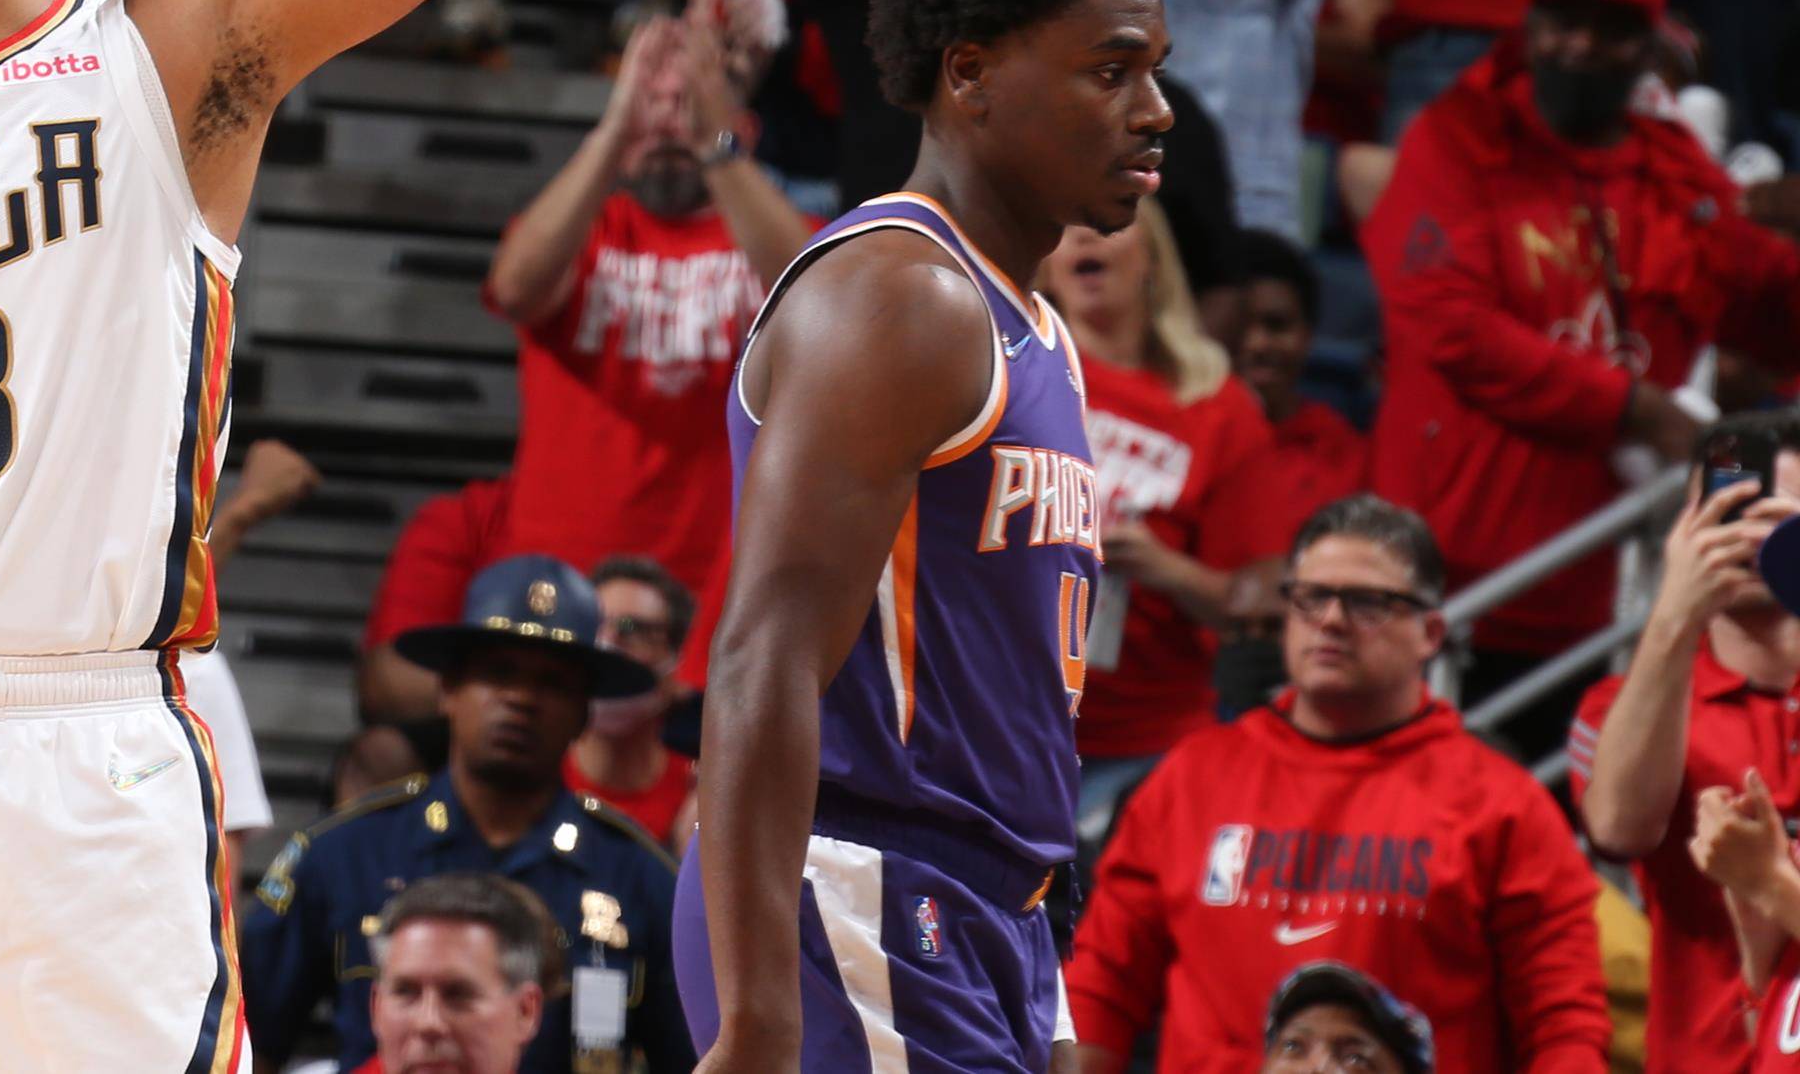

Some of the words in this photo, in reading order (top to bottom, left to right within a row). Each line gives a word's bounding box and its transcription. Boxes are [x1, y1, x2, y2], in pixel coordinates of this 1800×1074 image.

[2, 51, 101, 83] ibotta
[977, 444, 1104, 564] PHOE
[1247, 829, 1433, 899] PELICANS
